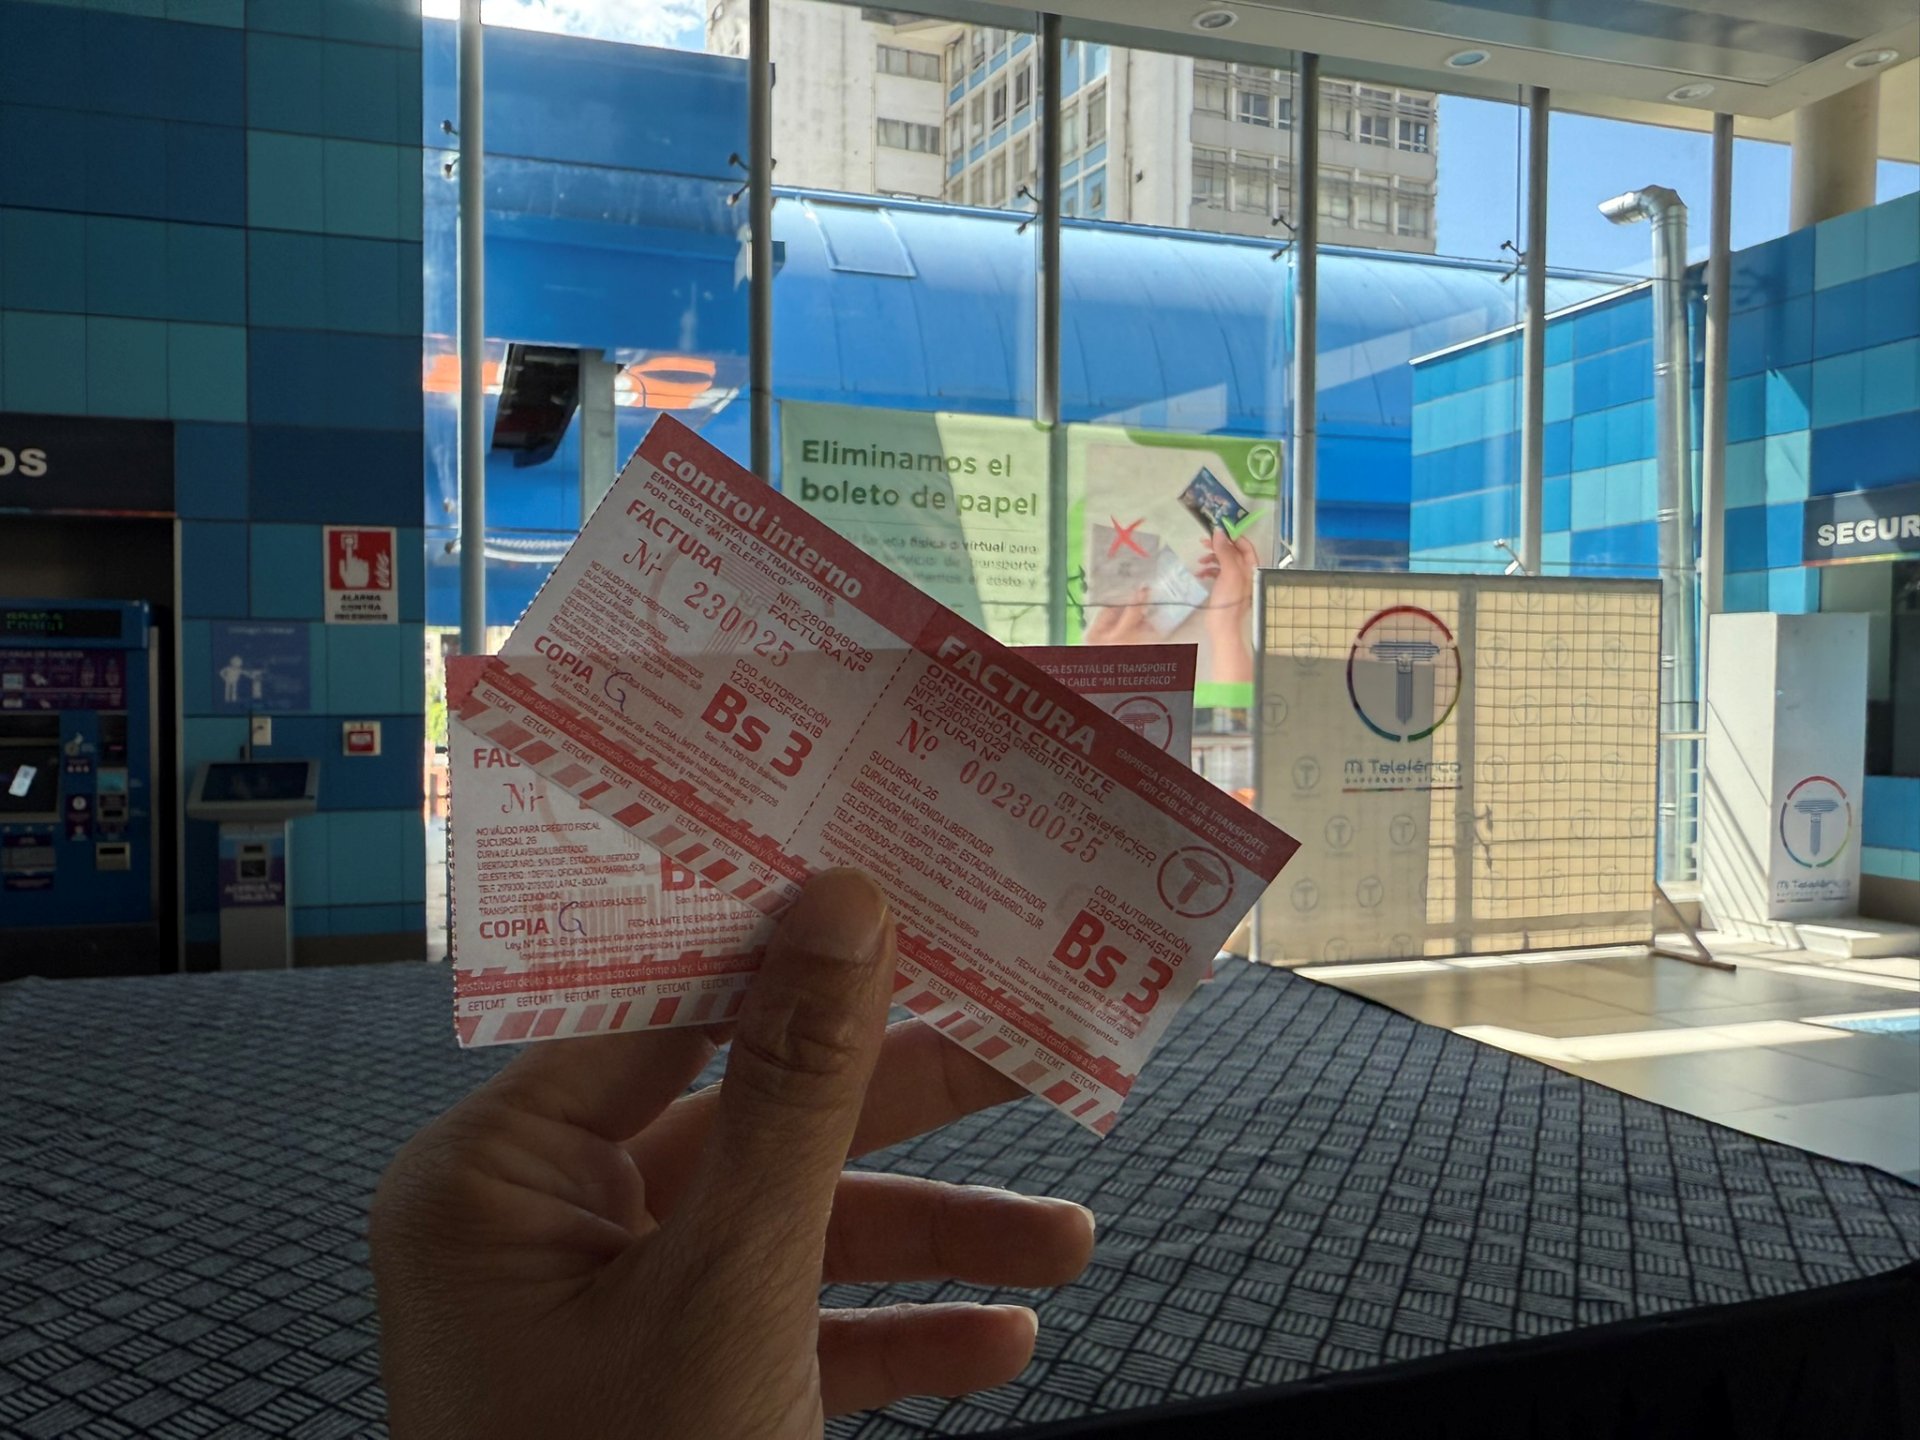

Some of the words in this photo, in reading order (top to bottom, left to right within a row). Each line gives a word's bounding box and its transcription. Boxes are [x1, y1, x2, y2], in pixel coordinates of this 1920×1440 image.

[803, 440, 977, 475] Eliminamos
[988, 454, 1011, 477] el
[642, 481, 668, 503] POR
[666, 498, 704, 528] CABLE
[659, 447, 766, 532] control
[761, 514, 868, 601] interno
[801, 477, 899, 506] boleto
[911, 484, 946, 509] de
[957, 493, 1037, 518] papel
[624, 497, 727, 577] FACTURA
[649, 470, 704, 512] EMPRESA
[702, 508, 751, 546] ESTATAL
[749, 540, 766, 555] DE
[764, 550, 837, 606] TRANSPORTE
[962, 541, 1005, 553] virtual
[1817, 514, 1920, 547] SEGUR
[583, 569, 623, 599] SUCURSAL
[667, 613, 691, 633] FISCAL
[682, 578, 797, 670] 230025
[767, 603, 844, 662] FACTURA
[775, 591, 802, 615] NIT:
[799, 607, 875, 665] 280048029
[531, 633, 597, 684] COPIA
[1061, 664, 1100, 674] ESTATAL
[1103, 664, 1114, 674] DE
[1117, 662, 1177, 674] TRANSPORTE
[1068, 677, 1097, 687] CABLE
[597, 712, 616, 728] para
[734, 657, 761, 680] COD.
[759, 674, 832, 728] AUTORIZACIÓN
[909, 683, 937, 706] NIT:
[934, 699, 1011, 756] 280048029
[936, 633, 1101, 755] FACTURA
[521, 714, 555, 740] EETCMT
[599, 764, 632, 790] EETCMT
[643, 729, 676, 754] servicios
[652, 719, 678, 740] FECHA
[697, 750, 710, 762] DE
[699, 681, 779, 755] Bs
[768, 727, 816, 781] 3
[902, 695, 980, 752] FACTURA
[917, 673, 946, 697] CON
[944, 691, 1004, 735] DERECHO
[1000, 728, 1014, 742] A
[1011, 734, 1066, 776] CRÉDITO
[1062, 770, 1107, 804] FISCAL
[924, 662, 1027, 735] ORIGINAL
[1026, 729, 1116, 794] CLIENTE
[867, 749, 925, 792] SUCURSAL
[921, 784, 939, 802] 26
[1114, 746, 1159, 781] EMPRESA
[1156, 775, 1198, 807] ESTATAL
[1194, 800, 1209, 815] DE
[1207, 809, 1270, 855] TRANSPORTE
[1136, 778, 1157, 796] POR
[1155, 790, 1186, 815] CABLE
[518, 824, 540, 832] PARA
[575, 821, 600, 830] FISCAL
[824, 819, 861, 848] ACTIVIDAD
[859, 762, 889, 788] CURVA
[886, 781, 901, 796] DE
[897, 788, 912, 803] LA
[909, 795, 946, 825] AVENIDA
[942, 818, 995, 857] LIBERTADOR
[957, 757, 1103, 866] 00230025
[1075, 801, 1160, 862] Teleférico
[476, 837, 523, 847] SUCURSAL
[818, 846, 837, 862] Ley
[818, 829, 866, 864] TRANSPORTE
[864, 858, 895, 882] URBANO
[902, 883, 928, 904] CARGA
[840, 791, 879, 822] CELESTE
[934, 852, 970, 880] OFICINA
[1024, 911, 1045, 930] SUR
[849, 776, 902, 817] LIBERTADOR
[920, 823, 940, 842] S/N
[957, 848, 1000, 881] ESTACION
[996, 873, 1048, 912] LIBERTADOR
[922, 864, 935, 878] LA
[932, 871, 952, 889] PAZ
[954, 885, 989, 914] BOLIVIA
[478, 917, 550, 939] COPIA
[1084, 897, 1183, 967] 123629C5F4541B
[1093, 885, 1119, 906] COD.
[1117, 900, 1192, 954] AUTORIZACIÓN
[901, 913, 937, 939] efectuar
[936, 935, 978, 966] consultas
[984, 967, 1048, 1012] reclamaciones.
[934, 922, 973, 950] servicios
[972, 946, 995, 964] debe
[993, 959, 1030, 987] habilitar
[1028, 983, 1059, 1007] medios
[1064, 1006, 1120, 1046] instrumentos
[1013, 955, 1038, 975] FECHA
[1051, 907, 1136, 992] Bs
[1120, 953, 1176, 1018] 3
[1062, 970, 1079, 985] Tres
[1076, 979, 1107, 1003] 00/100
[468, 998, 506, 1010] EETCMT
[517, 994, 553, 1007] EETCMT
[564, 989, 600, 1002] EETCMT
[611, 986, 646, 998] EETCMT
[656, 981, 691, 993] EETCMT
[964, 981, 988, 1001] delito
[992, 1000, 1006, 1012] ser
[1045, 1033, 1083, 1063] conforme
[927, 977, 958, 1001] EETCMT
[963, 1000, 994, 1024] EETCMT
[998, 1023, 1029, 1048] EETCMT
[1033, 1046, 1065, 1071] EETCMT
[1069, 1070, 1101, 1095] EETCMT
